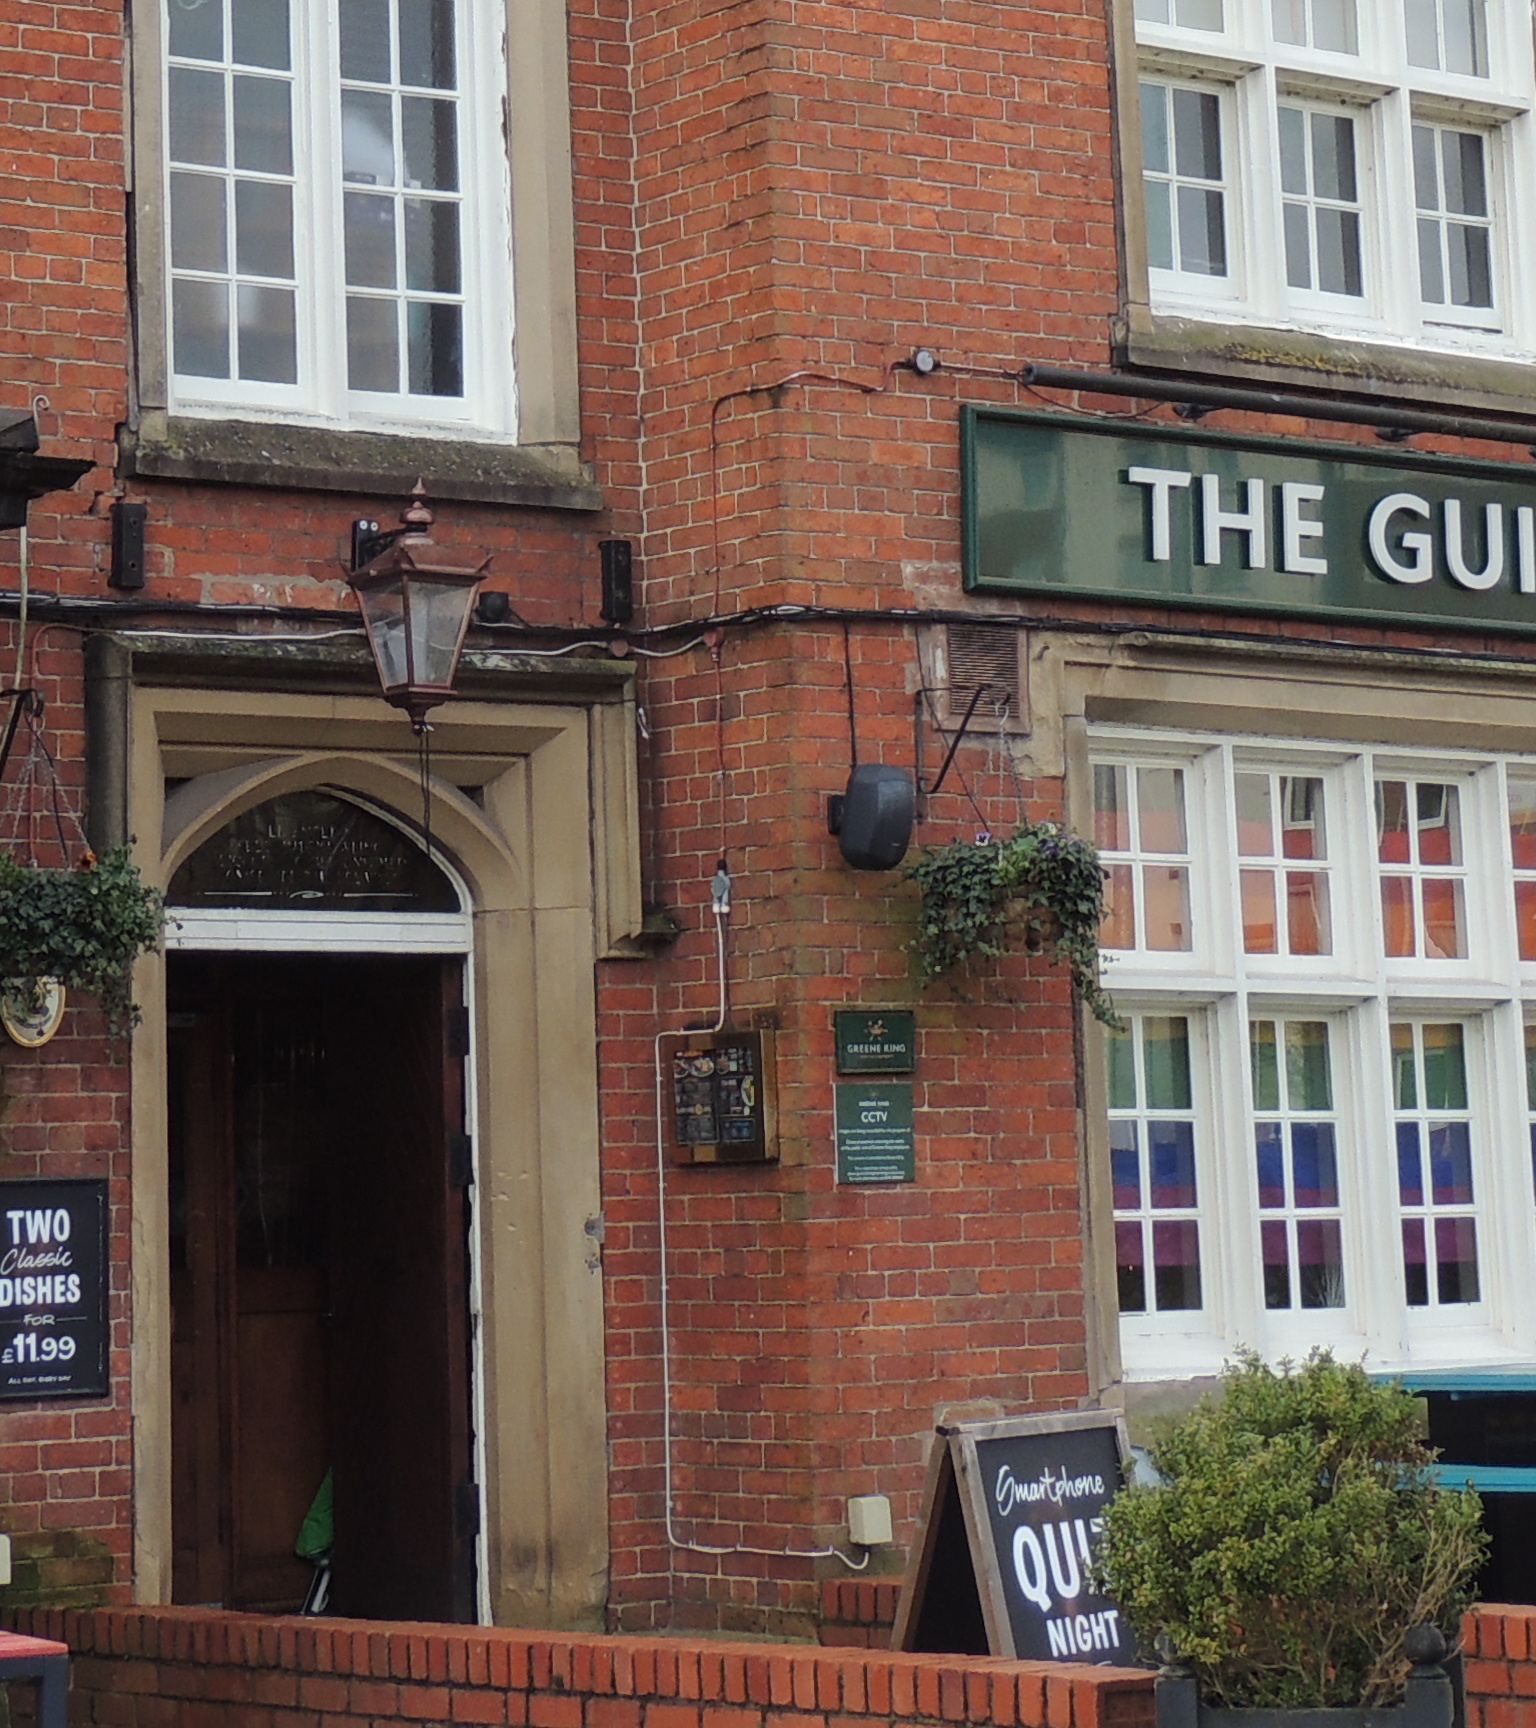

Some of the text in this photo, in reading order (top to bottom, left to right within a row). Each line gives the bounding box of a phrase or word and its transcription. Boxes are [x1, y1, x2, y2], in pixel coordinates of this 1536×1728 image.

[1127, 466, 1329, 575] THE
[847, 1043, 906, 1053] GREENE KING
[860, 1111, 888, 1123] CCTV
[6, 1208, 71, 1245] TWO
[0, 1246, 73, 1275] Classic
[23, 1314, 55, 1326] FOR
[1, 1332, 76, 1364] £11.99
[996, 1465, 1105, 1516] Smartphone
[1046, 1609, 1120, 1658] NIGHT
